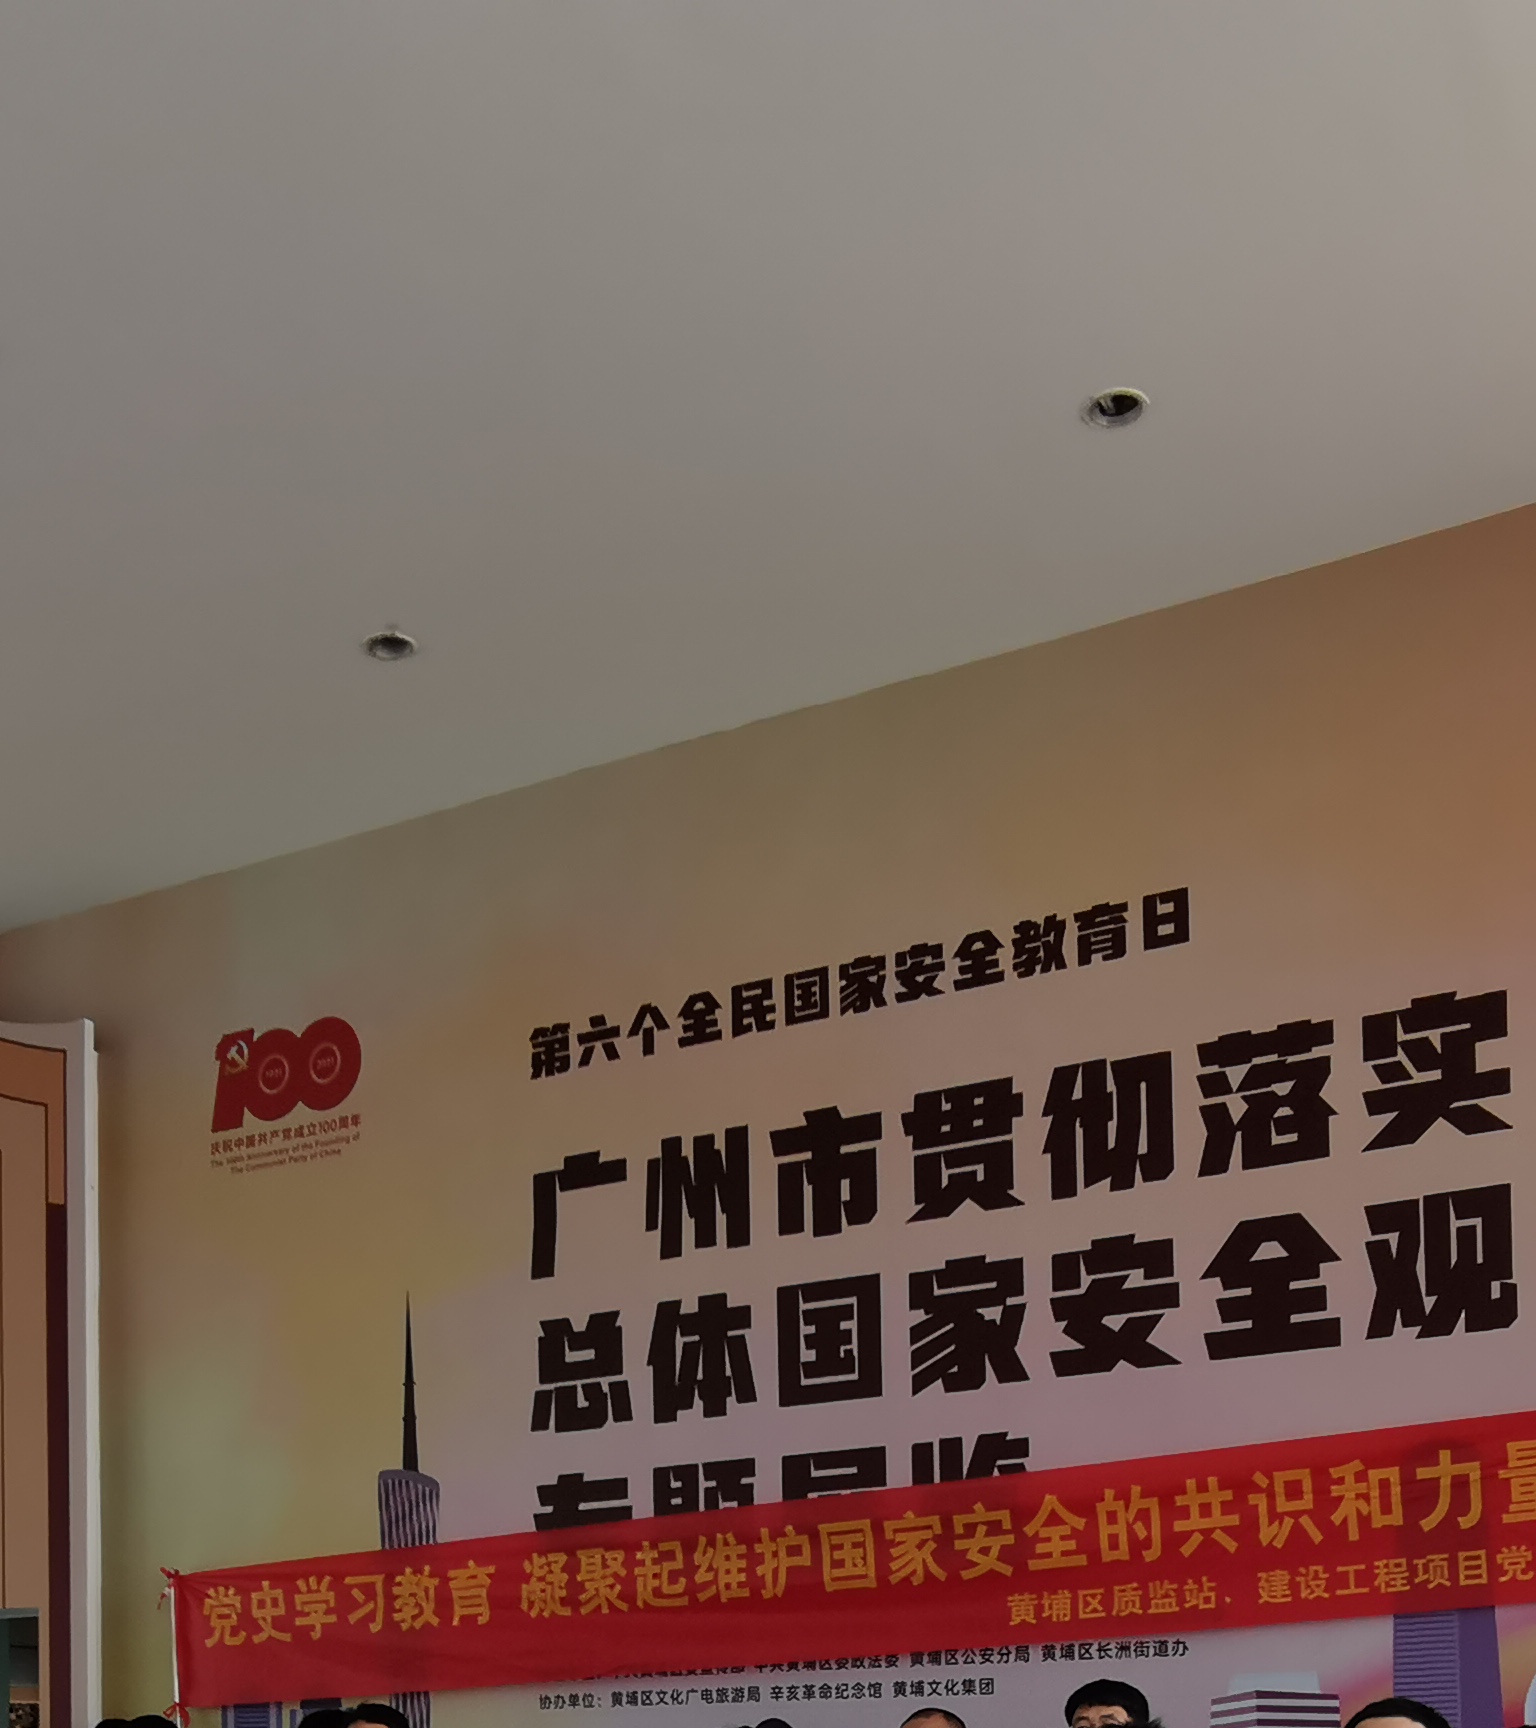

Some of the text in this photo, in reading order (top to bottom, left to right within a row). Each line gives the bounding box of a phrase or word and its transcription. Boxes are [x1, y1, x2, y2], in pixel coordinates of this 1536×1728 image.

[529, 887, 1190, 1079] 第六个全民国家安全教育日
[531, 988, 1514, 1280] 广州市贯彻落实
[531, 1183, 1518, 1433] 总体国家安全观
[202, 1560, 496, 1647] 党史学习教育
[1040, 1639, 1190, 1663] 黄埔区长洲街道办
[769, 1681, 883, 1702] 辛亥革命纪念馆
[892, 1677, 995, 1699] 黄埔文化集团
